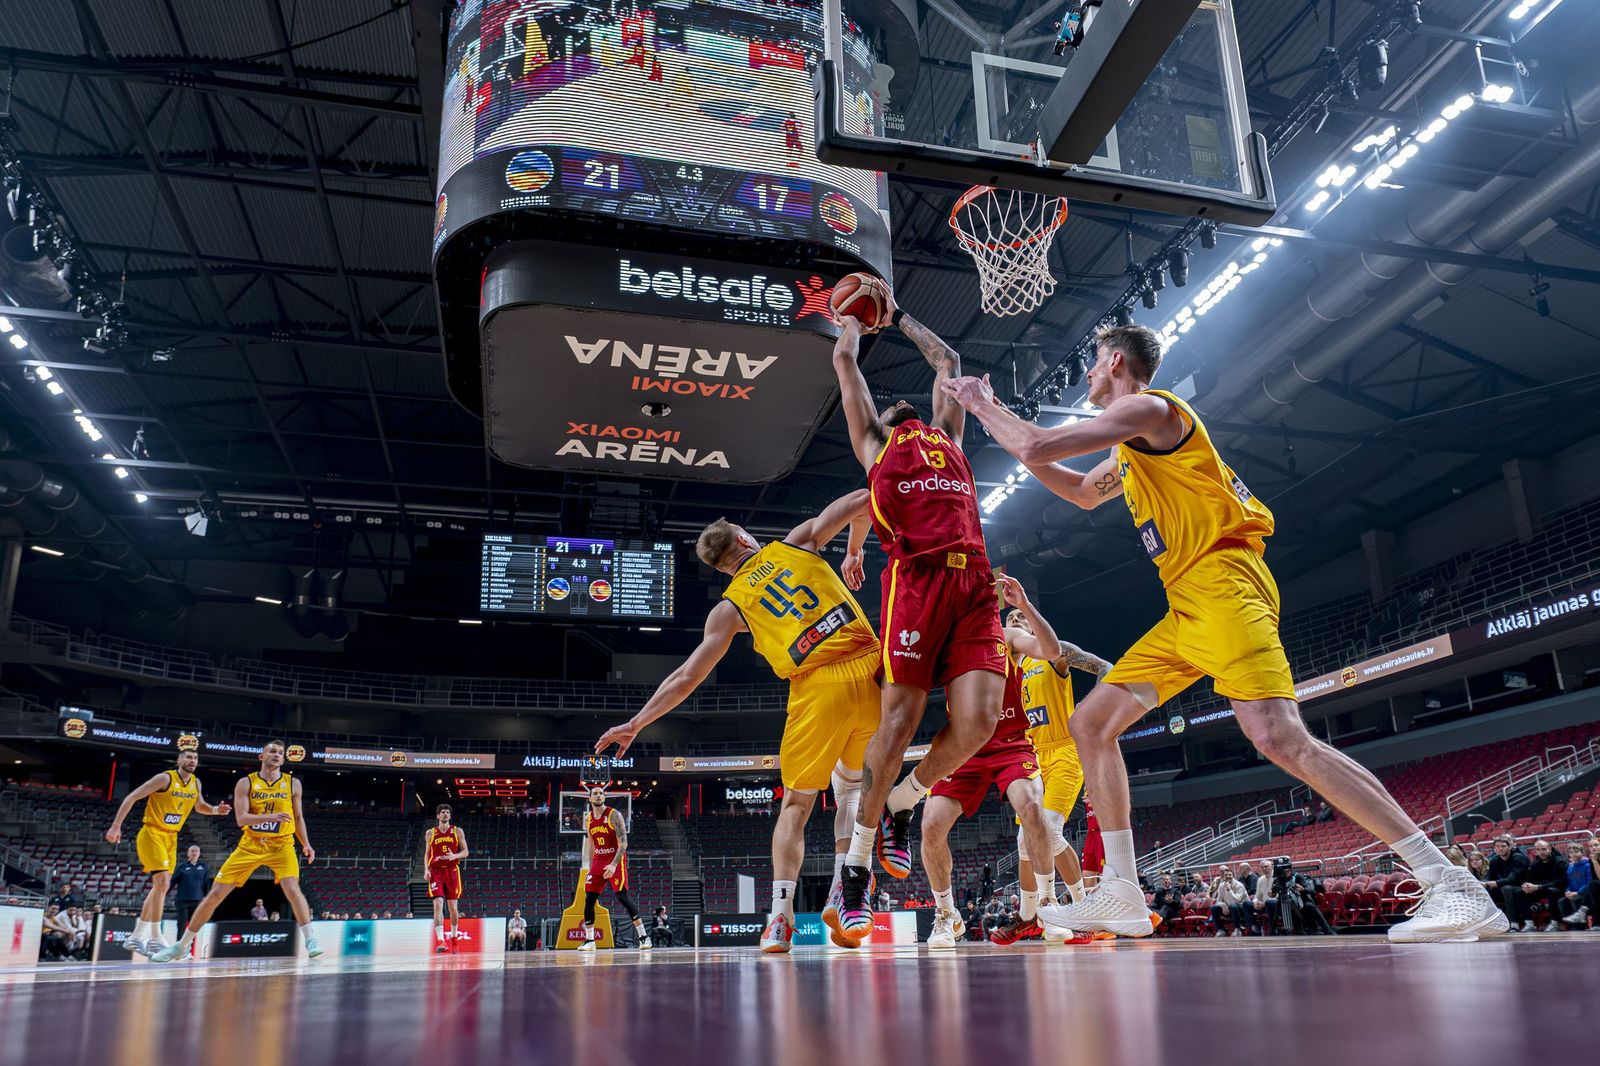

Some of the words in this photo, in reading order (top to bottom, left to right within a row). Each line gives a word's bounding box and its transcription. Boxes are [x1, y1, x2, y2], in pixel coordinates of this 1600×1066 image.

[583, 160, 619, 189] 21
[676, 165, 703, 181] 4.3
[501, 196, 550, 209] UKRAINE
[753, 184, 788, 212] 17
[620, 259, 793, 311] betsafe
[724, 309, 790, 325] SPORTS
[564, 336, 778, 379] ARĒNA
[632, 376, 755, 400] XIAOMI
[566, 422, 681, 442] XIAOMI
[555, 439, 730, 468] ARĒNA
[898, 474, 971, 495] endesa
[485, 535, 512, 543] UKRAINE
[556, 542, 569, 552] 21
[590, 544, 604, 555] 17
[654, 543, 672, 551] SPAIN
[572, 558, 587, 568] 4.3
[759, 569, 820, 620] 45
[1487, 610, 1532, 638] Atklāj
[1533, 594, 1589, 625] jaunas
[797, 608, 846, 654] GG.BET
[1363, 647, 1434, 675] www.vairaksaules.lv
[1028, 709, 1044, 724] GV
[93, 728, 171, 745] www.vairaksaules.lv
[312, 752, 383, 762] www.vairaksaules.lv
[414, 757, 480, 765] www.vairaksaules.lv
[522, 756, 555, 769] Atklāj
[556, 758, 592, 769] jaunas
[694, 759, 754, 767] www.vairaksaules.lv
[726, 787, 773, 800] betsafe
[262, 802, 275, 814] 34
[597, 837, 605, 845] 10
[721, 924, 763, 933] TISSOT
[241, 933, 288, 943] TISSOT
